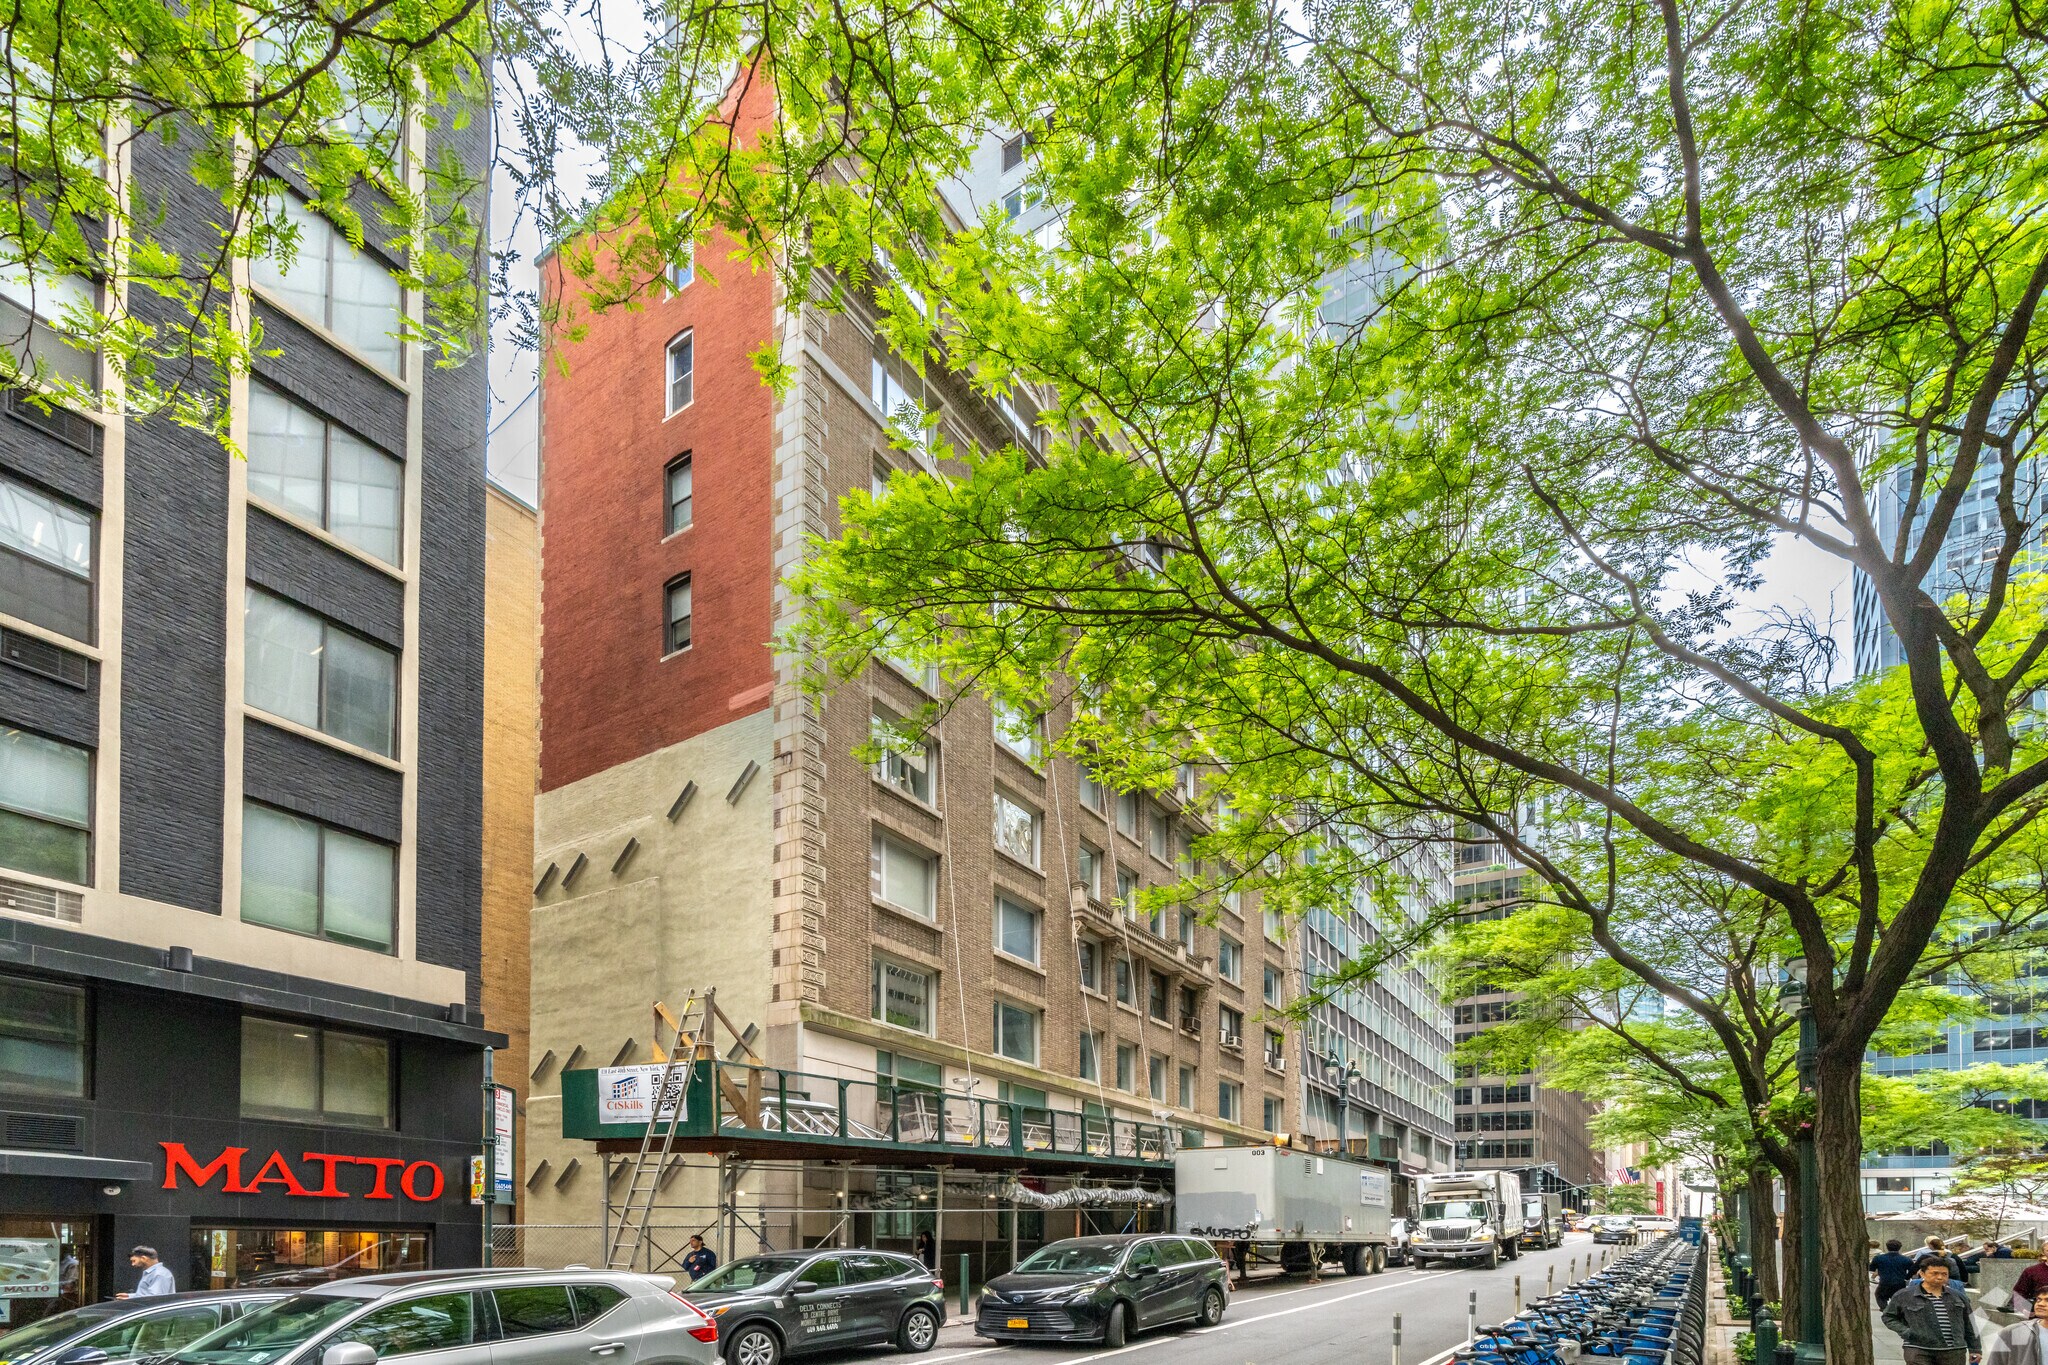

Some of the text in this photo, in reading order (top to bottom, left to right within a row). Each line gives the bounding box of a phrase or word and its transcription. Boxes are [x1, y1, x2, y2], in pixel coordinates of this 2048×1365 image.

[496, 1089, 500, 1098] 3
[607, 1100, 643, 1110] CtSkills
[496, 1135, 500, 1144] 2
[158, 1141, 445, 1202] MATTO
[800, 1302, 841, 1312] DELTA CONNECTS
